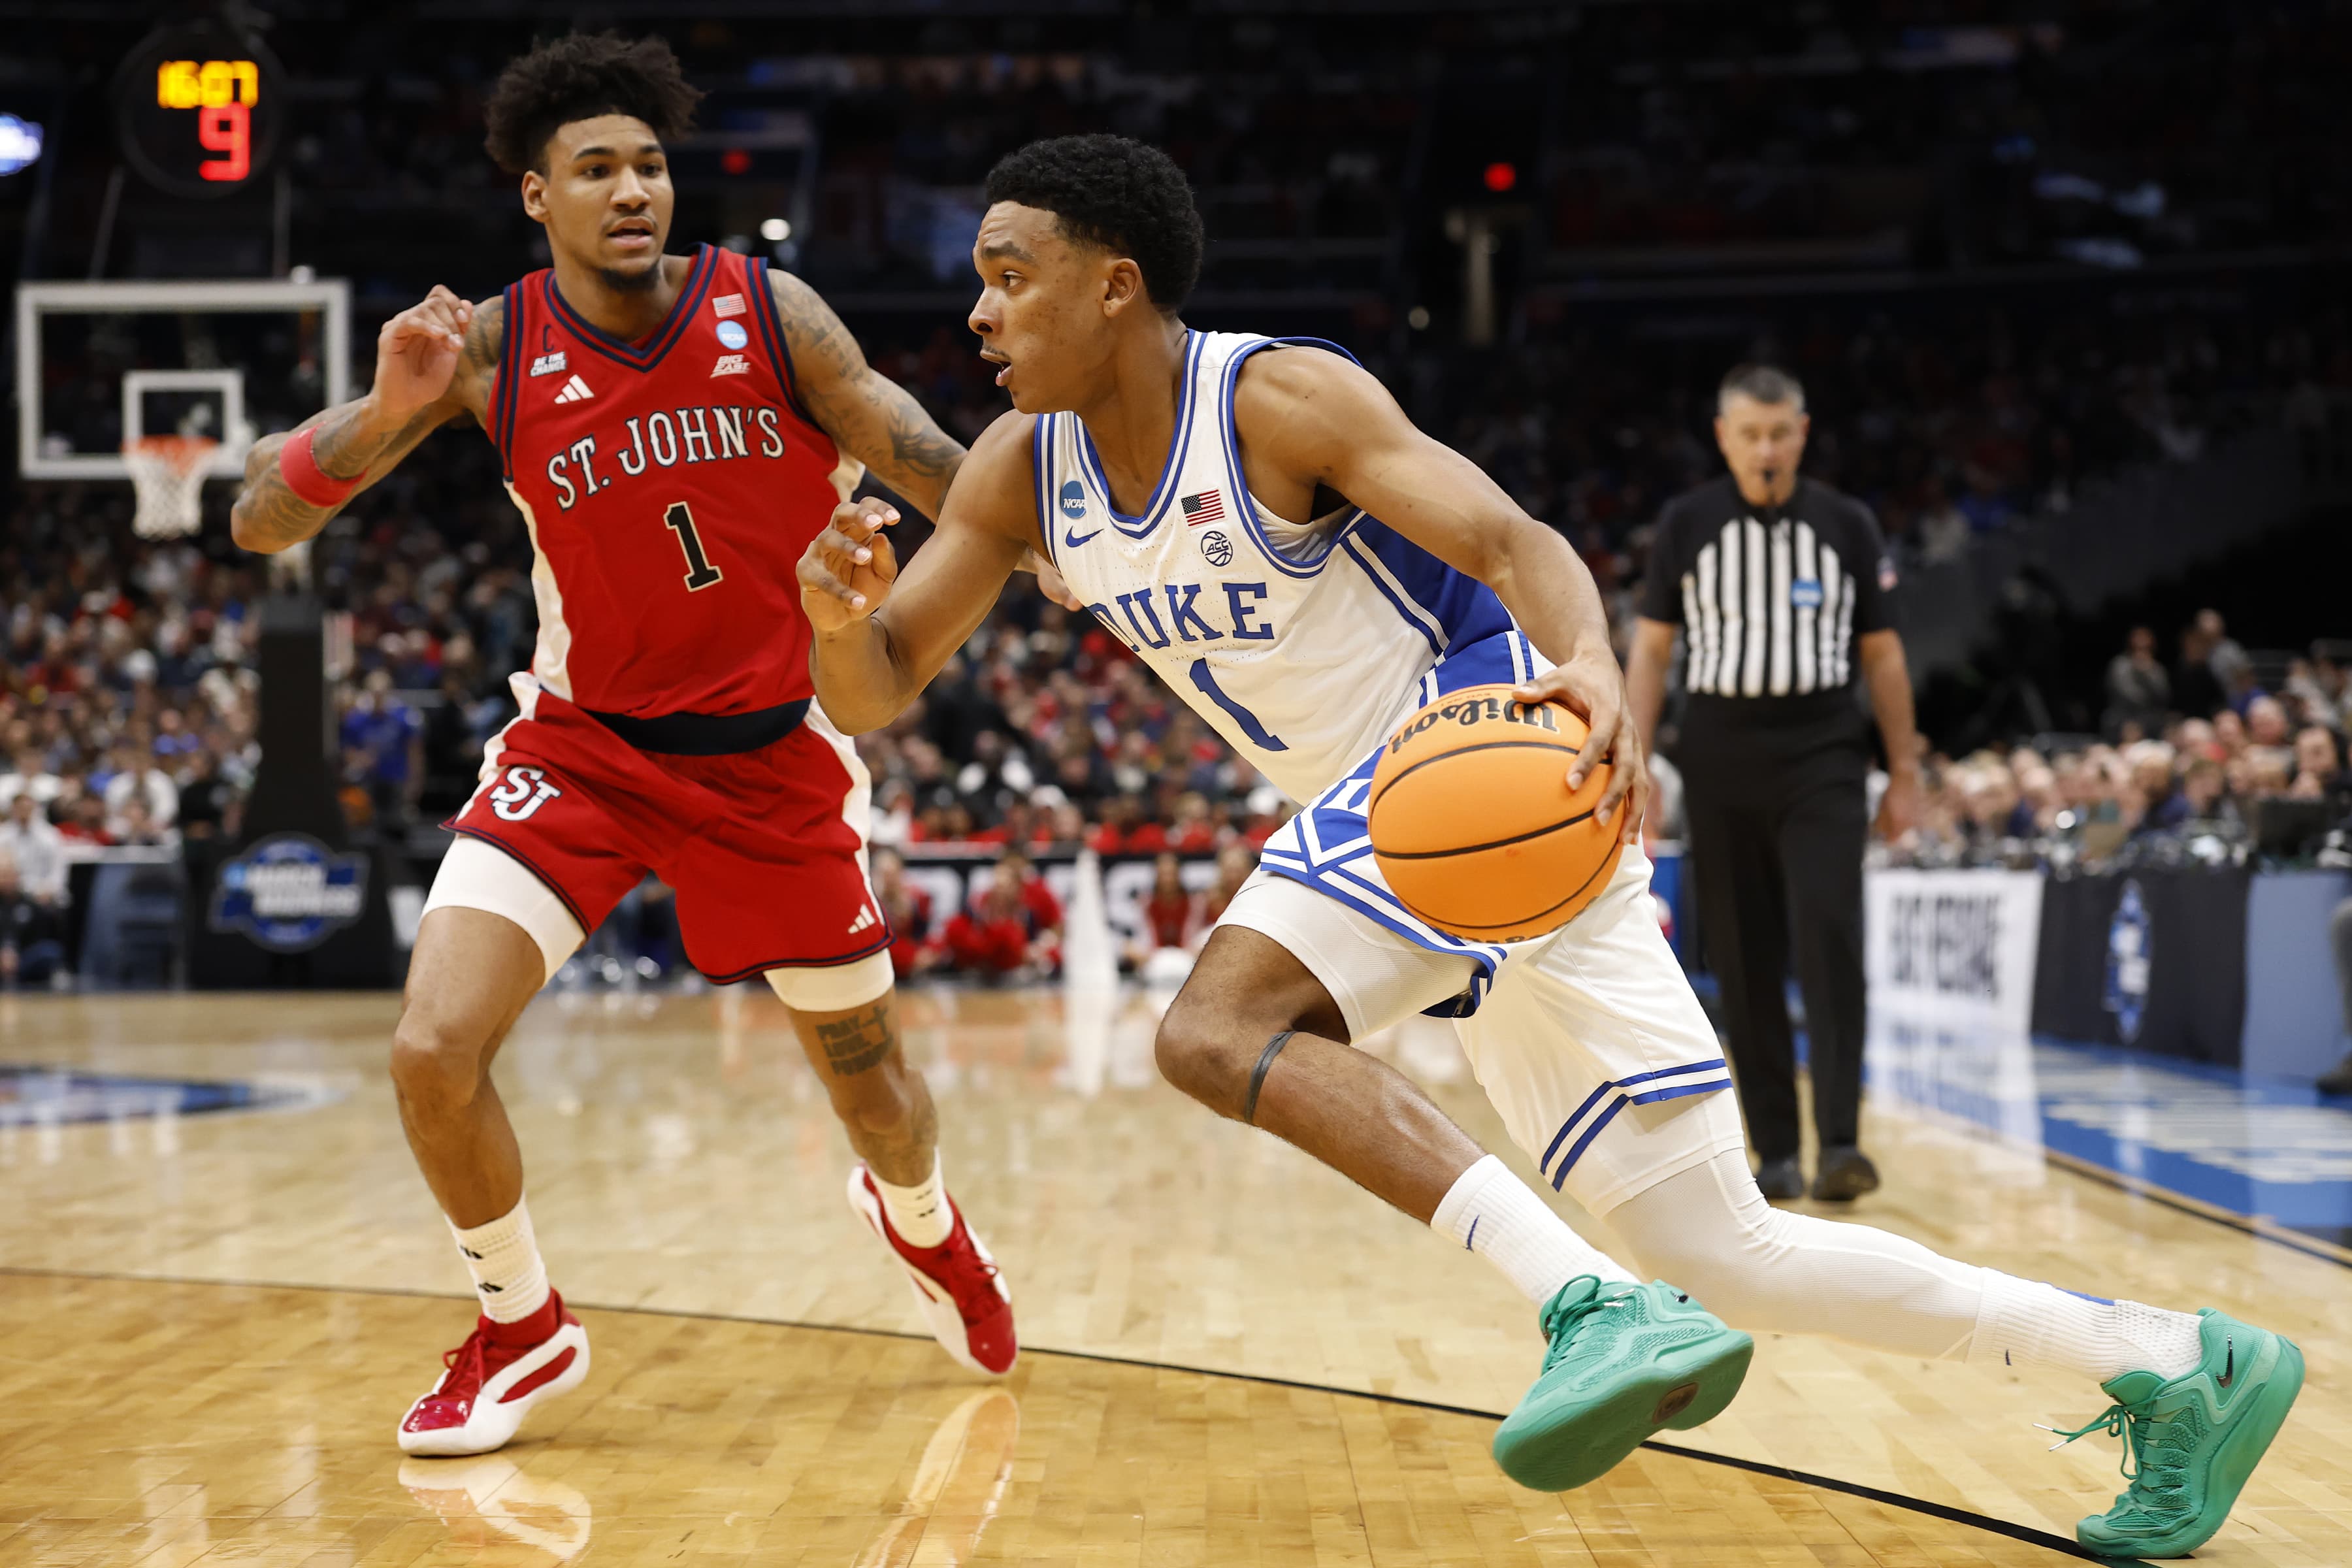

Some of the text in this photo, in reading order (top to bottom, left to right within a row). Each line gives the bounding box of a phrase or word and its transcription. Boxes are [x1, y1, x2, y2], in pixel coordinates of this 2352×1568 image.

[199, 102, 250, 180] 9
[531, 360, 566, 377] CHANGE
[713, 362, 751, 374] EAST
[719, 355, 744, 363] BIG
[547, 406, 785, 512] ST. JOHN'S
[1063, 498, 1086, 508] NCAA
[663, 501, 723, 593] 1
[1207, 539, 1229, 553] ACC
[1190, 658, 1289, 751] 1
[1392, 697, 1560, 753] Wilson
